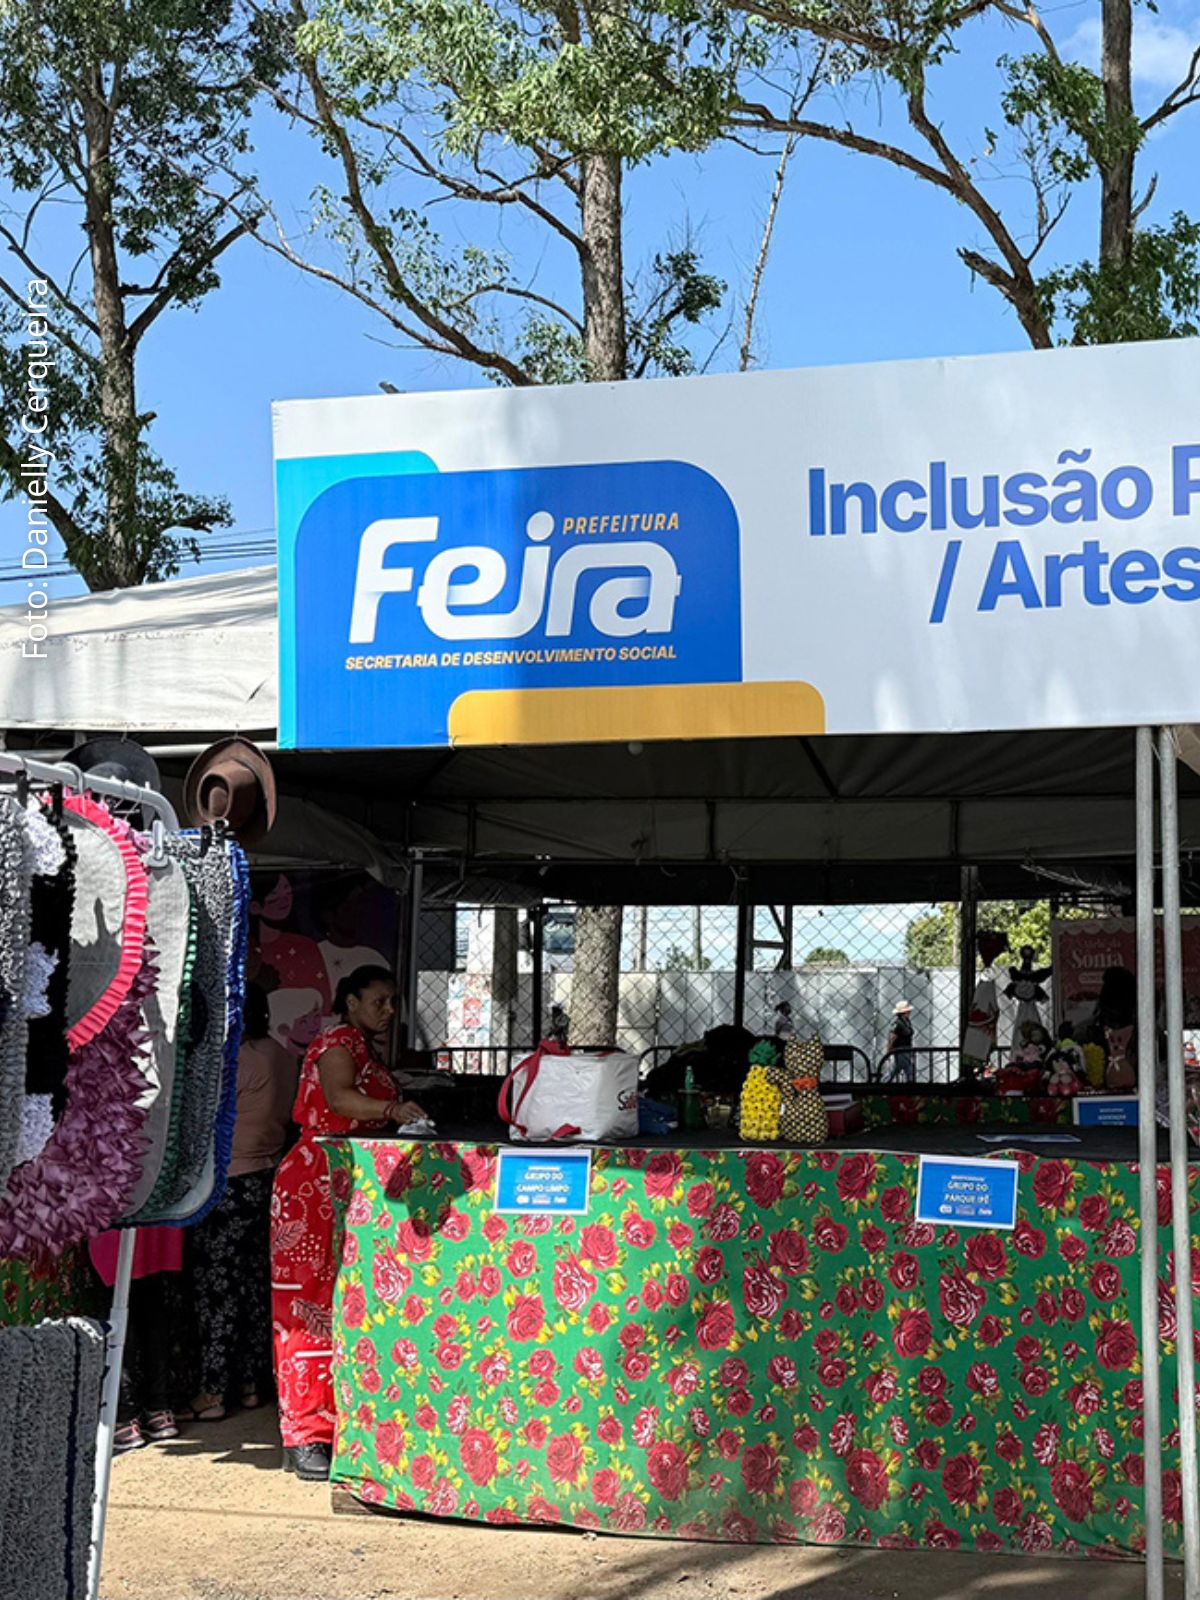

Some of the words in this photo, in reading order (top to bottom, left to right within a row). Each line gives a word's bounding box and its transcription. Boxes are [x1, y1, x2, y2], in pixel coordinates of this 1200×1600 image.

[808, 447, 1154, 536] Inclusão
[562, 512, 680, 535] PREFEITURA
[349, 511, 682, 644] Feira
[345, 653, 438, 670] SECRETARIA
[441, 652, 461, 666] DE
[463, 648, 616, 666] DESENVOLVIMENTO
[619, 645, 677, 660] SOCIAL
[944, 1193, 975, 1203] PARQUE
[947, 1181, 974, 1190] GRUPO
[975, 1184, 989, 1192] DO
